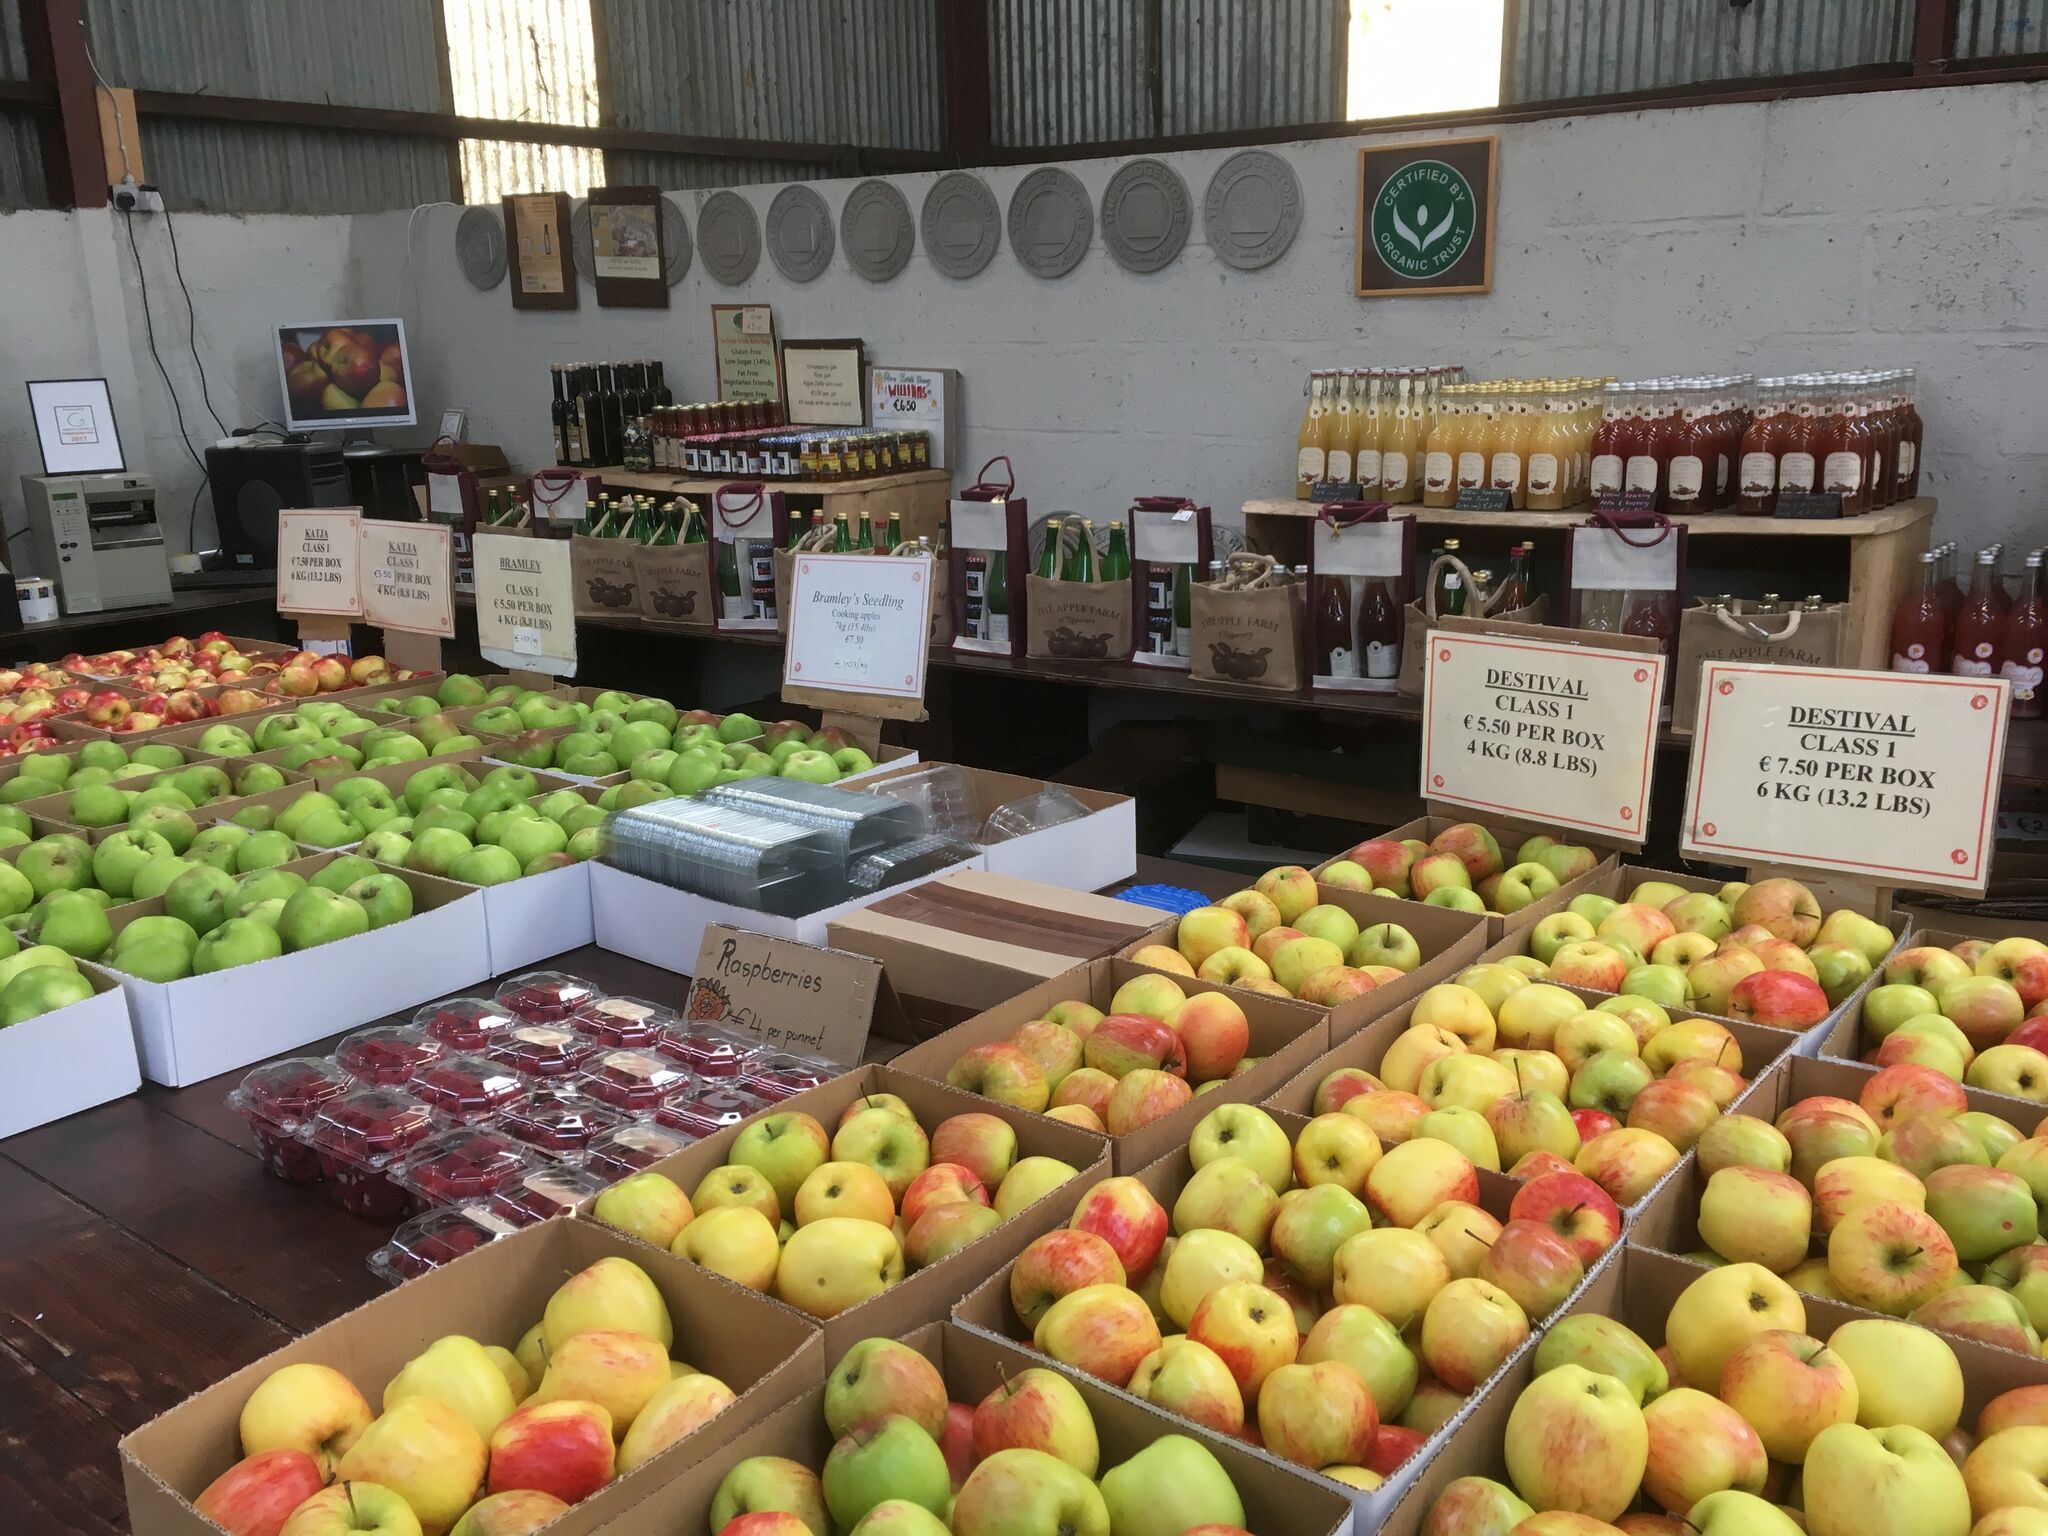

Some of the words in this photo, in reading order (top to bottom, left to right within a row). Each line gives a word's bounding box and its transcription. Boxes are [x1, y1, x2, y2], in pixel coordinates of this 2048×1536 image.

[1384, 168, 1449, 207] CERTIFIED
[1449, 182, 1466, 202] BY
[1380, 232, 1428, 271] ORGANIC
[1432, 226, 1466, 267] TRUST
[737, 369, 746, 377] Fat
[747, 369, 759, 377] Free
[304, 528, 329, 541] KATJA
[302, 543, 325, 553] CLASS
[388, 541, 418, 555] KATJA
[309, 557, 323, 568] PER
[325, 557, 342, 568] BOX
[386, 556, 414, 568] CLASS
[499, 557, 541, 571] BRAMLEY
[295, 571, 307, 582] KG
[307, 571, 323, 583] (13.2
[324, 572, 342, 584] LBS)
[397, 573, 413, 584] PER
[414, 574, 432, 586] BOX
[383, 585, 396, 597] KG
[397, 586, 410, 599] (8.8
[411, 588, 430, 601] LBS)
[505, 584, 533, 597] CLASS
[500, 599, 516, 610] 5.50
[517, 600, 534, 613] PER
[535, 603, 553, 615] BOX
[812, 590, 860, 607] Bramley's
[862, 593, 904, 611] Seedling
[831, 609, 859, 621] Cooking
[860, 611, 881, 622] apples
[1037, 604, 1053, 616] THE
[1056, 603, 1087, 613] APPLE
[1090, 605, 1120, 621] FARM
[504, 615, 518, 626] KG
[533, 619, 552, 632] LBS)
[835, 621, 847, 631] 7kg
[1200, 615, 1216, 628] THE
[1247, 616, 1280, 633] FARM
[1729, 646, 1773, 659] APPLE
[1779, 646, 1821, 665] FARM
[1485, 668, 1589, 699] DESTIVAL
[1495, 694, 1560, 718] CLASS
[1566, 703, 1574, 720] 1
[1788, 705, 1917, 736] DESTIVAL
[1463, 714, 1473, 730] €
[1477, 716, 1511, 736] 5.50
[1516, 721, 1556, 743] PER
[1562, 729, 1606, 751] BOX
[1800, 733, 1879, 757] CLASS
[1887, 741, 1896, 758] 1
[1467, 739, 1476, 754] 4
[1481, 740, 1510, 760] KG
[1515, 746, 1547, 767] (8.8
[1553, 752, 1598, 778] LBS)
[1759, 755, 1772, 772] €
[1777, 756, 1818, 777] 7.50
[1825, 760, 1873, 783] PER
[1881, 767, 1936, 789] BOX
[1757, 781, 1768, 798] 6
[1774, 782, 1810, 802] KG
[1817, 786, 1868, 809] (13.2
[1875, 790, 1931, 819] LBS)
[716, 938, 823, 993] Raspberries
[766, 1026, 781, 1040] per
[783, 1025, 825, 1050] punnet
